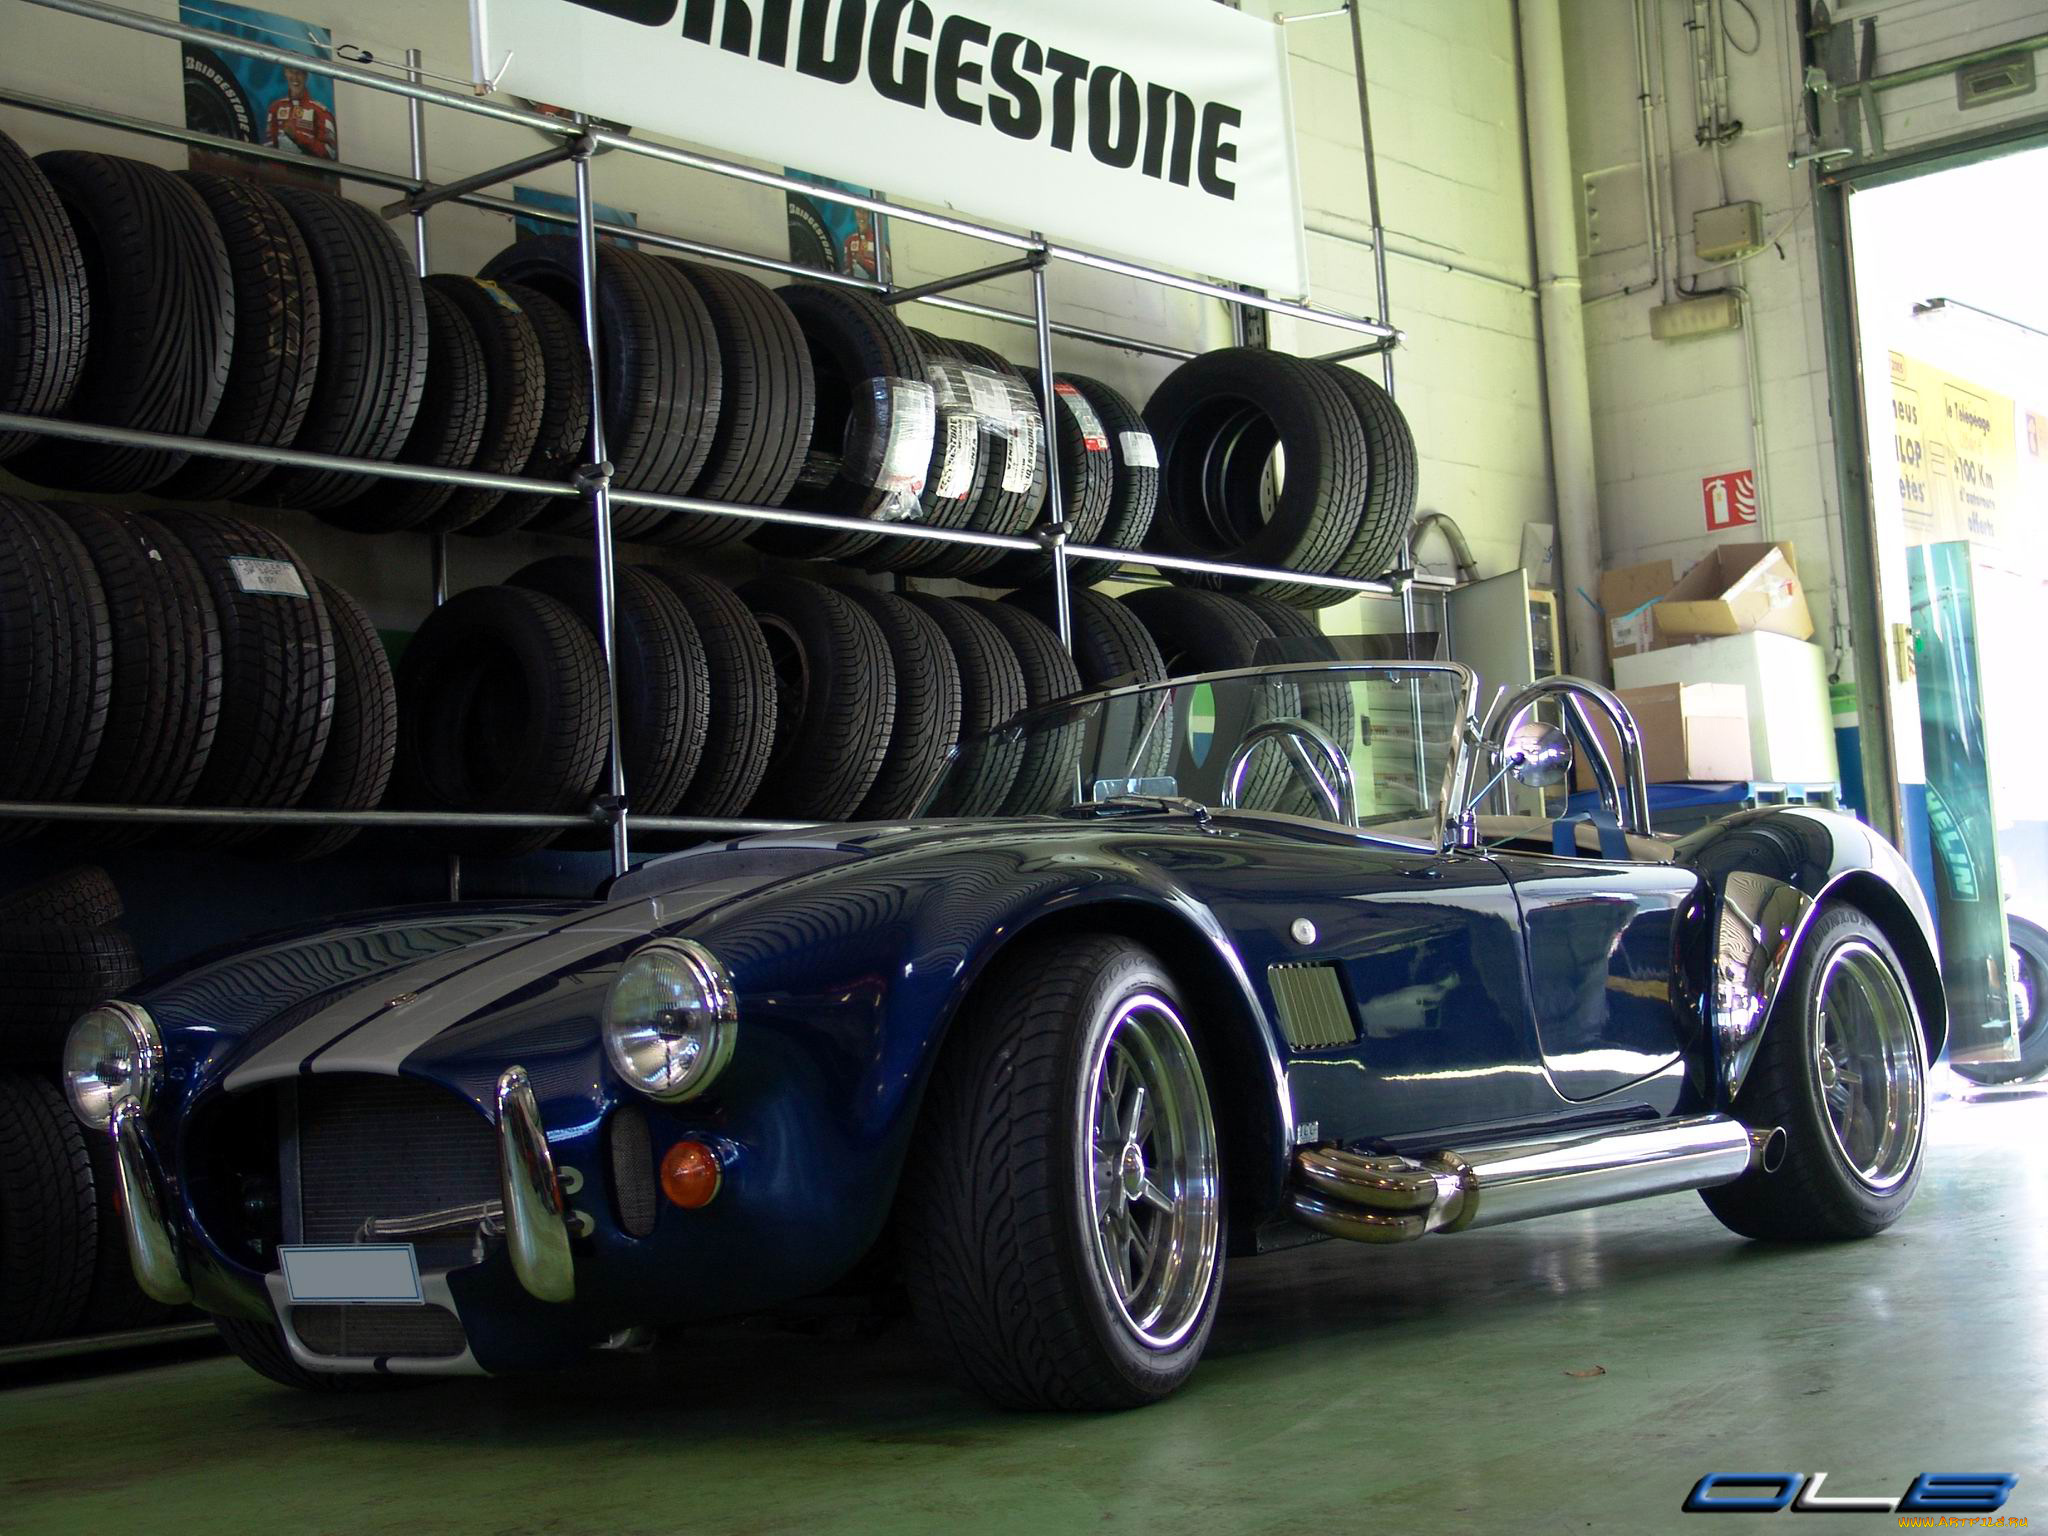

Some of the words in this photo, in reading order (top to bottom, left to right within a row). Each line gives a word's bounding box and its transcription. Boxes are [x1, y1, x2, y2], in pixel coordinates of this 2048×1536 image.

[185, 56, 250, 132] BRIDGESTONE
[789, 203, 835, 263] BRIDGESTONE
[1977, 463, 1994, 489] Km
